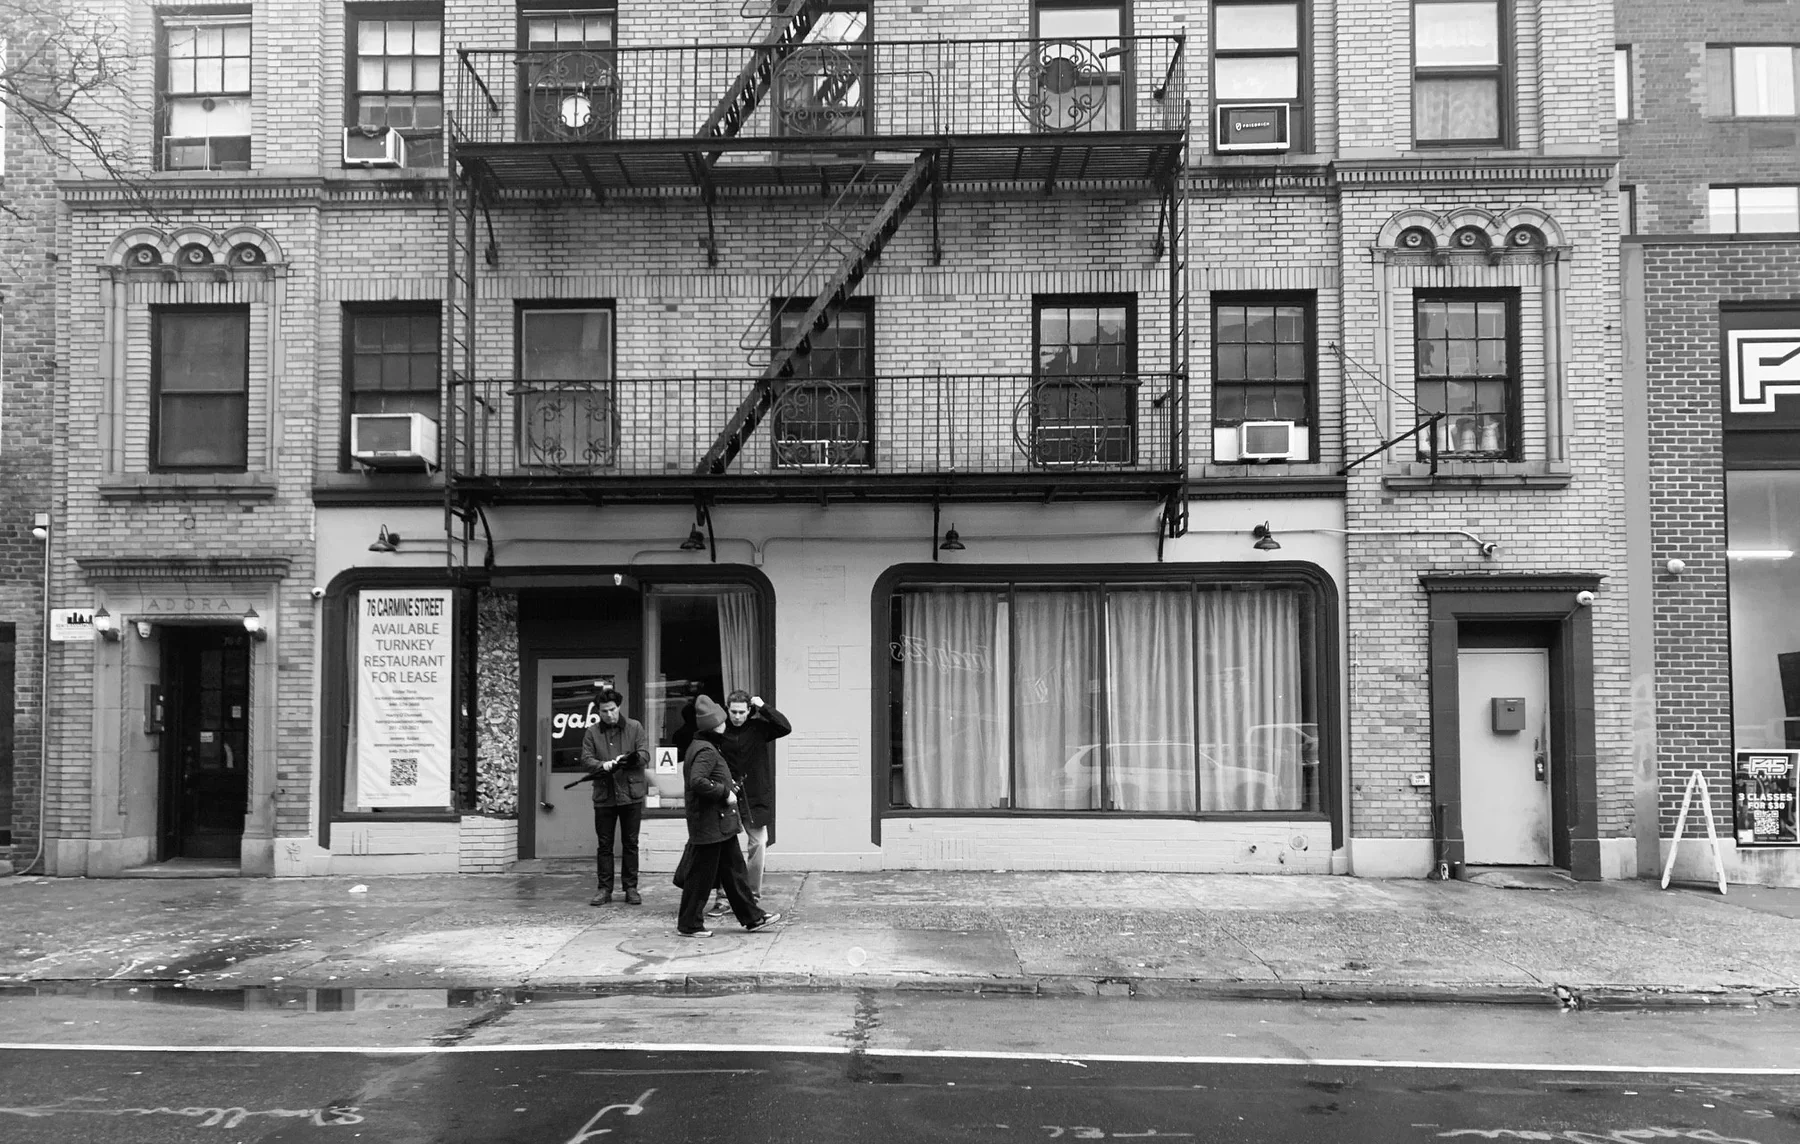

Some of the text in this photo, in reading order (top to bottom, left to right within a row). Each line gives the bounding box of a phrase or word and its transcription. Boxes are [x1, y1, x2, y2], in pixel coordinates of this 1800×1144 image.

[147, 597, 231, 611] ADORA
[366, 597, 445, 616] 76 CARMINE STREET
[371, 623, 439, 635] AVAILABLE
[376, 639, 435, 651] TURNKEY
[364, 655, 445, 667] RESTAURANT
[371, 671, 438, 683] FOR LEASE
[660, 751, 674, 766] A
[1749, 756, 1788, 774] F45
[1738, 793, 1793, 801] 3 CLASSES
